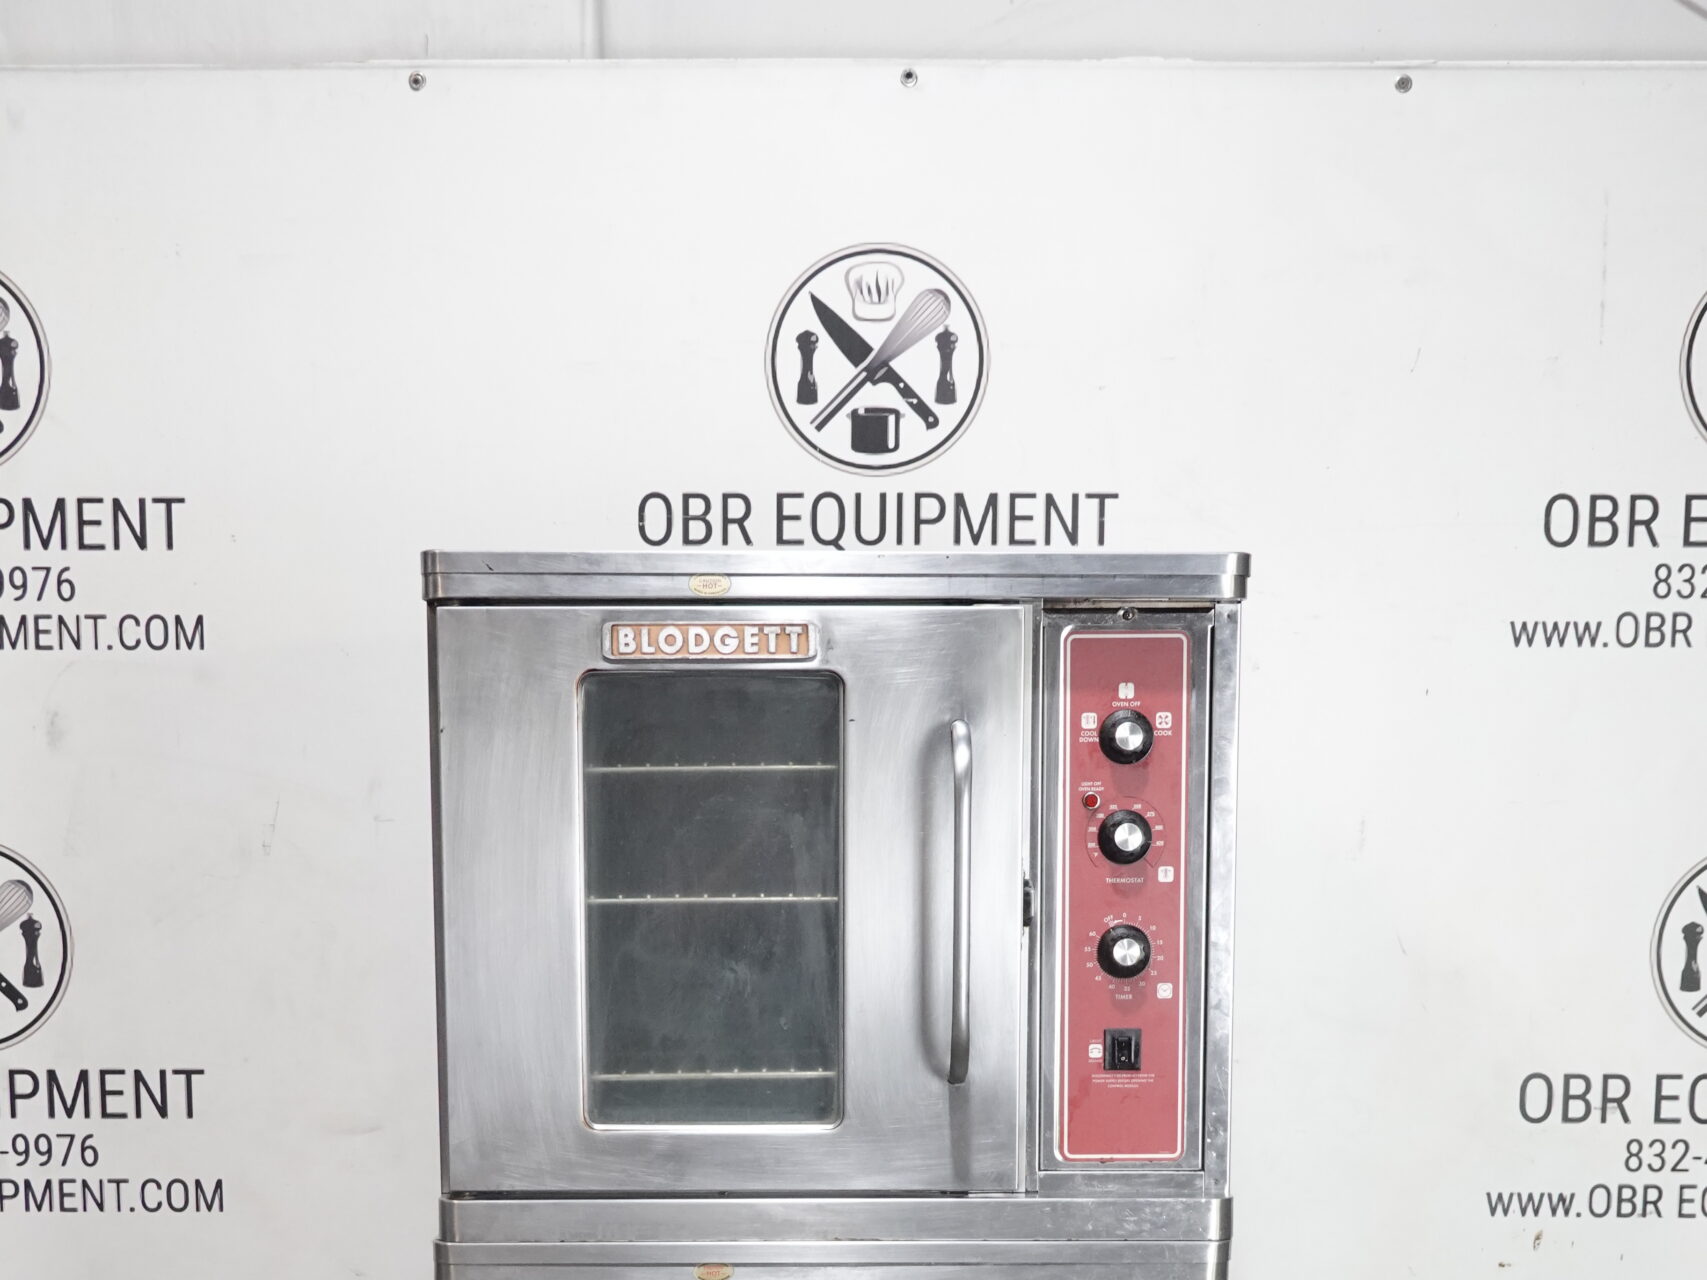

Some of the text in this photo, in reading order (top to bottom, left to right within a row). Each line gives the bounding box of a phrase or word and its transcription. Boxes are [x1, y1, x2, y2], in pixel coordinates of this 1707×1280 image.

[638, 491, 1119, 551] OBR EQUIPMENT
[1544, 493, 1660, 548] OBR
[0, 566, 76, 602] 976
[0, 614, 205, 651] MENT.COM
[617, 626, 803, 655] BLODGETT
[1510, 611, 1693, 648] www.OBR
[8, 1069, 205, 1119] PMENT
[1519, 1072, 1632, 1124] OBR
[0, 1133, 99, 1167] -9976
[1624, 1138, 1707, 1173] 832-
[0, 1178, 224, 1212] PMENT.COM
[1486, 1183, 1664, 1219] www.OBR
